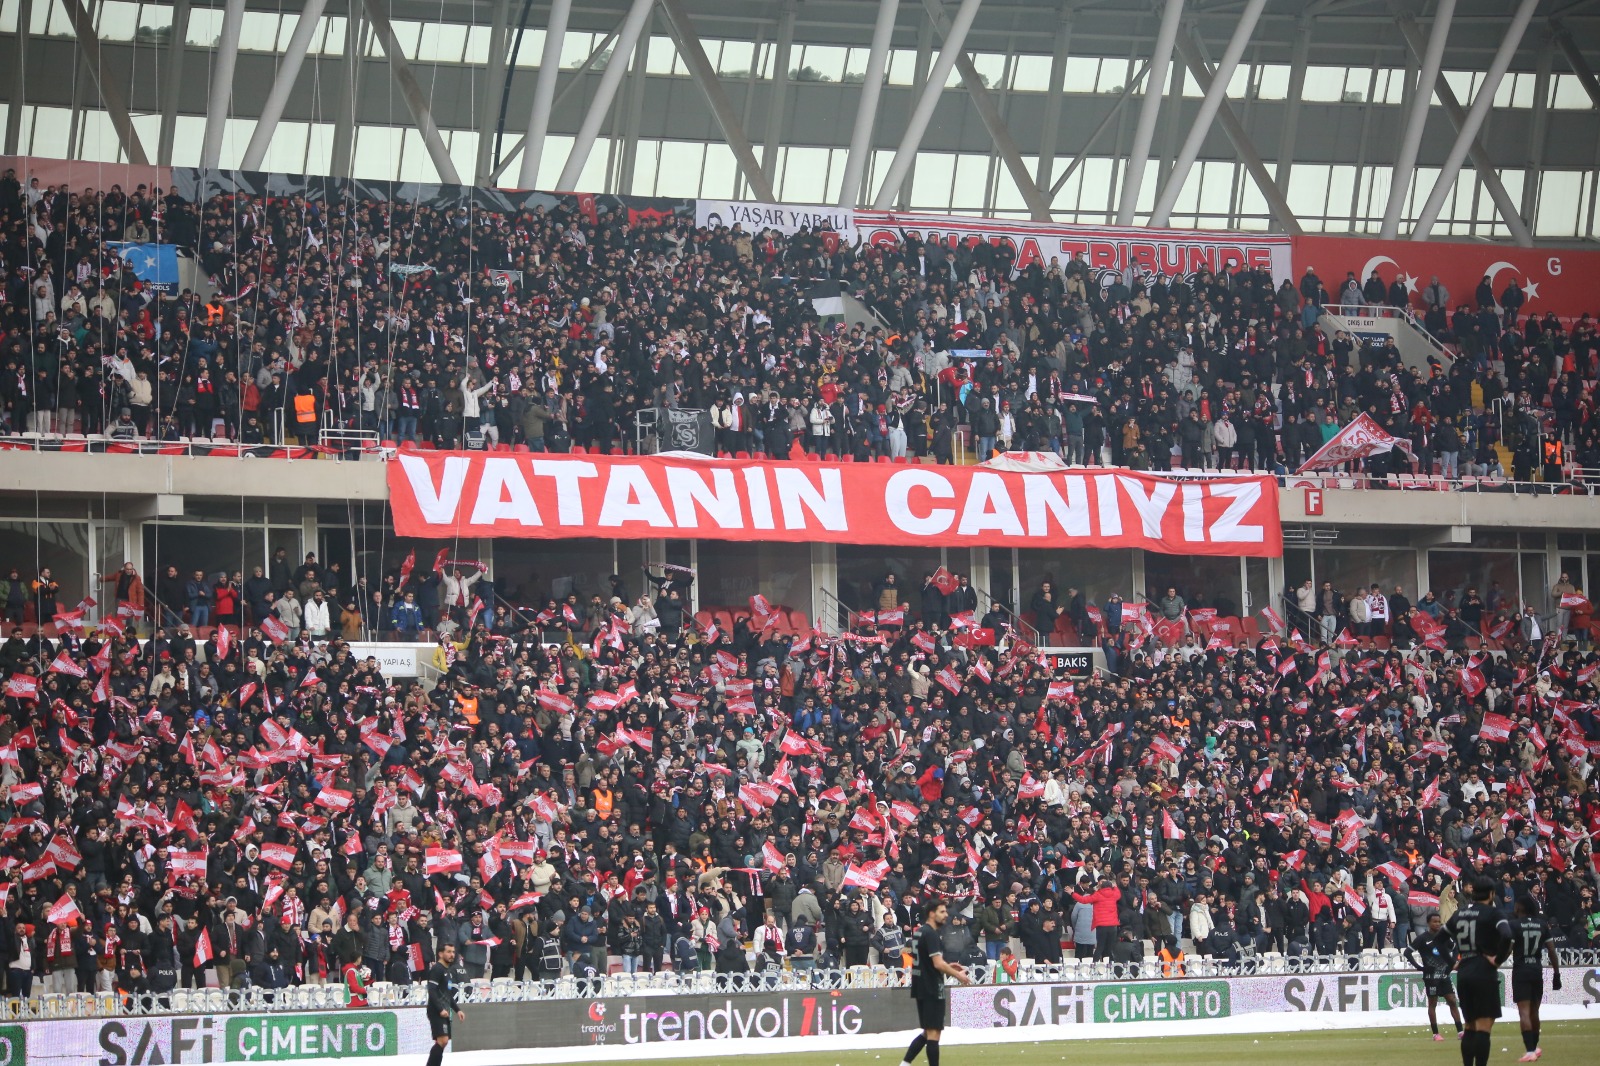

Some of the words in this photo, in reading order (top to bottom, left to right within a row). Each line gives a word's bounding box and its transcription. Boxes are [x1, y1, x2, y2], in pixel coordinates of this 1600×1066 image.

[730, 205, 784, 227] YAŞAR
[1547, 257, 1562, 276] G
[398, 453, 848, 532] VATANIN
[884, 468, 1264, 543] CANIYIZ
[1309, 491, 1319, 512] F
[383, 658, 399, 666] YAPI
[1456, 919, 1477, 951] 21
[1522, 930, 1541, 956] 17
[1103, 987, 1222, 1023] ÇİMENTO
[581, 1022, 616, 1034] trendyol
[620, 999, 789, 1044] trendyol
[238, 1019, 386, 1061] ÇİMENTO
